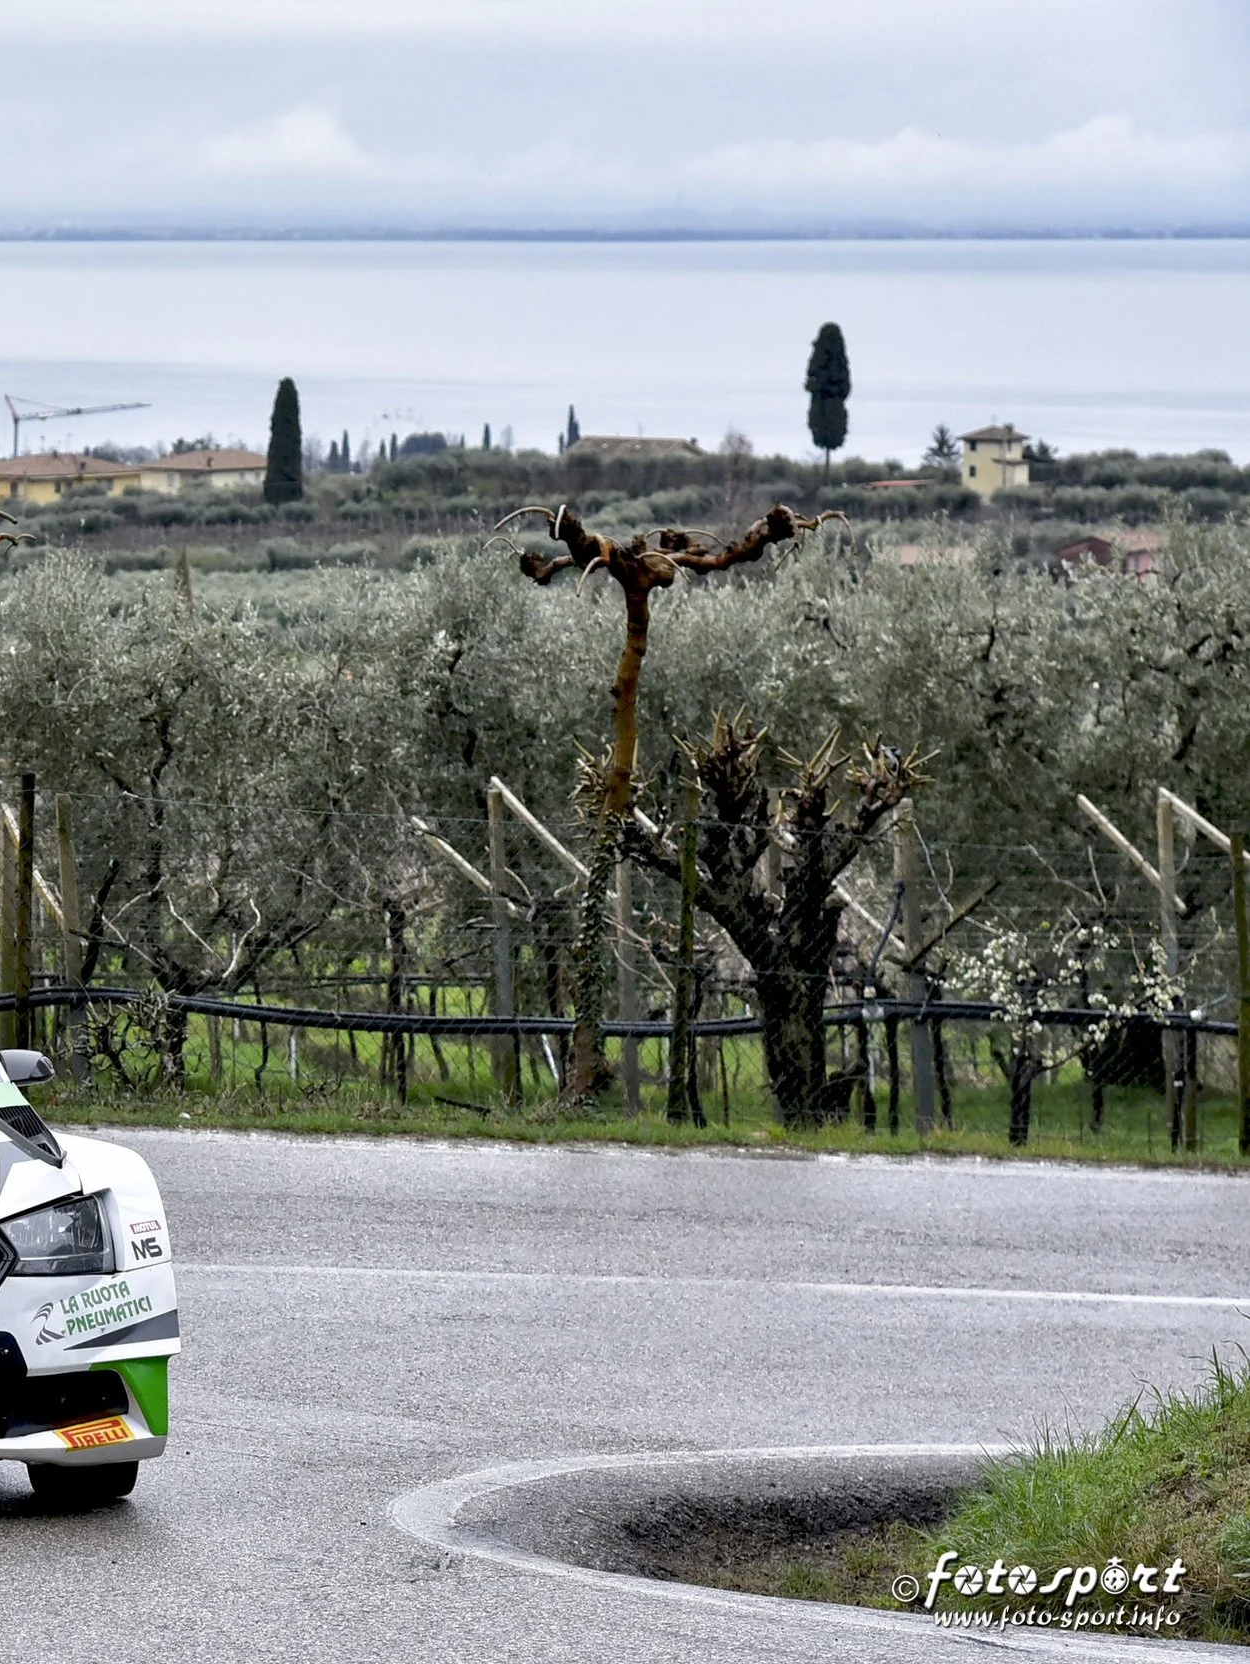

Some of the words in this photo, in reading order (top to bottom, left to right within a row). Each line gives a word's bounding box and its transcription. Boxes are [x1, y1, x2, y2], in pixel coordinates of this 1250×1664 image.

[132, 1221, 160, 1234] MOTUL
[131, 1237, 163, 1261] MS
[60, 1296, 80, 1315] LA
[80, 1280, 131, 1308] RUOTA
[65, 1295, 153, 1336] PNEUMATICI
[61, 1419, 128, 1449] PIRELLI
